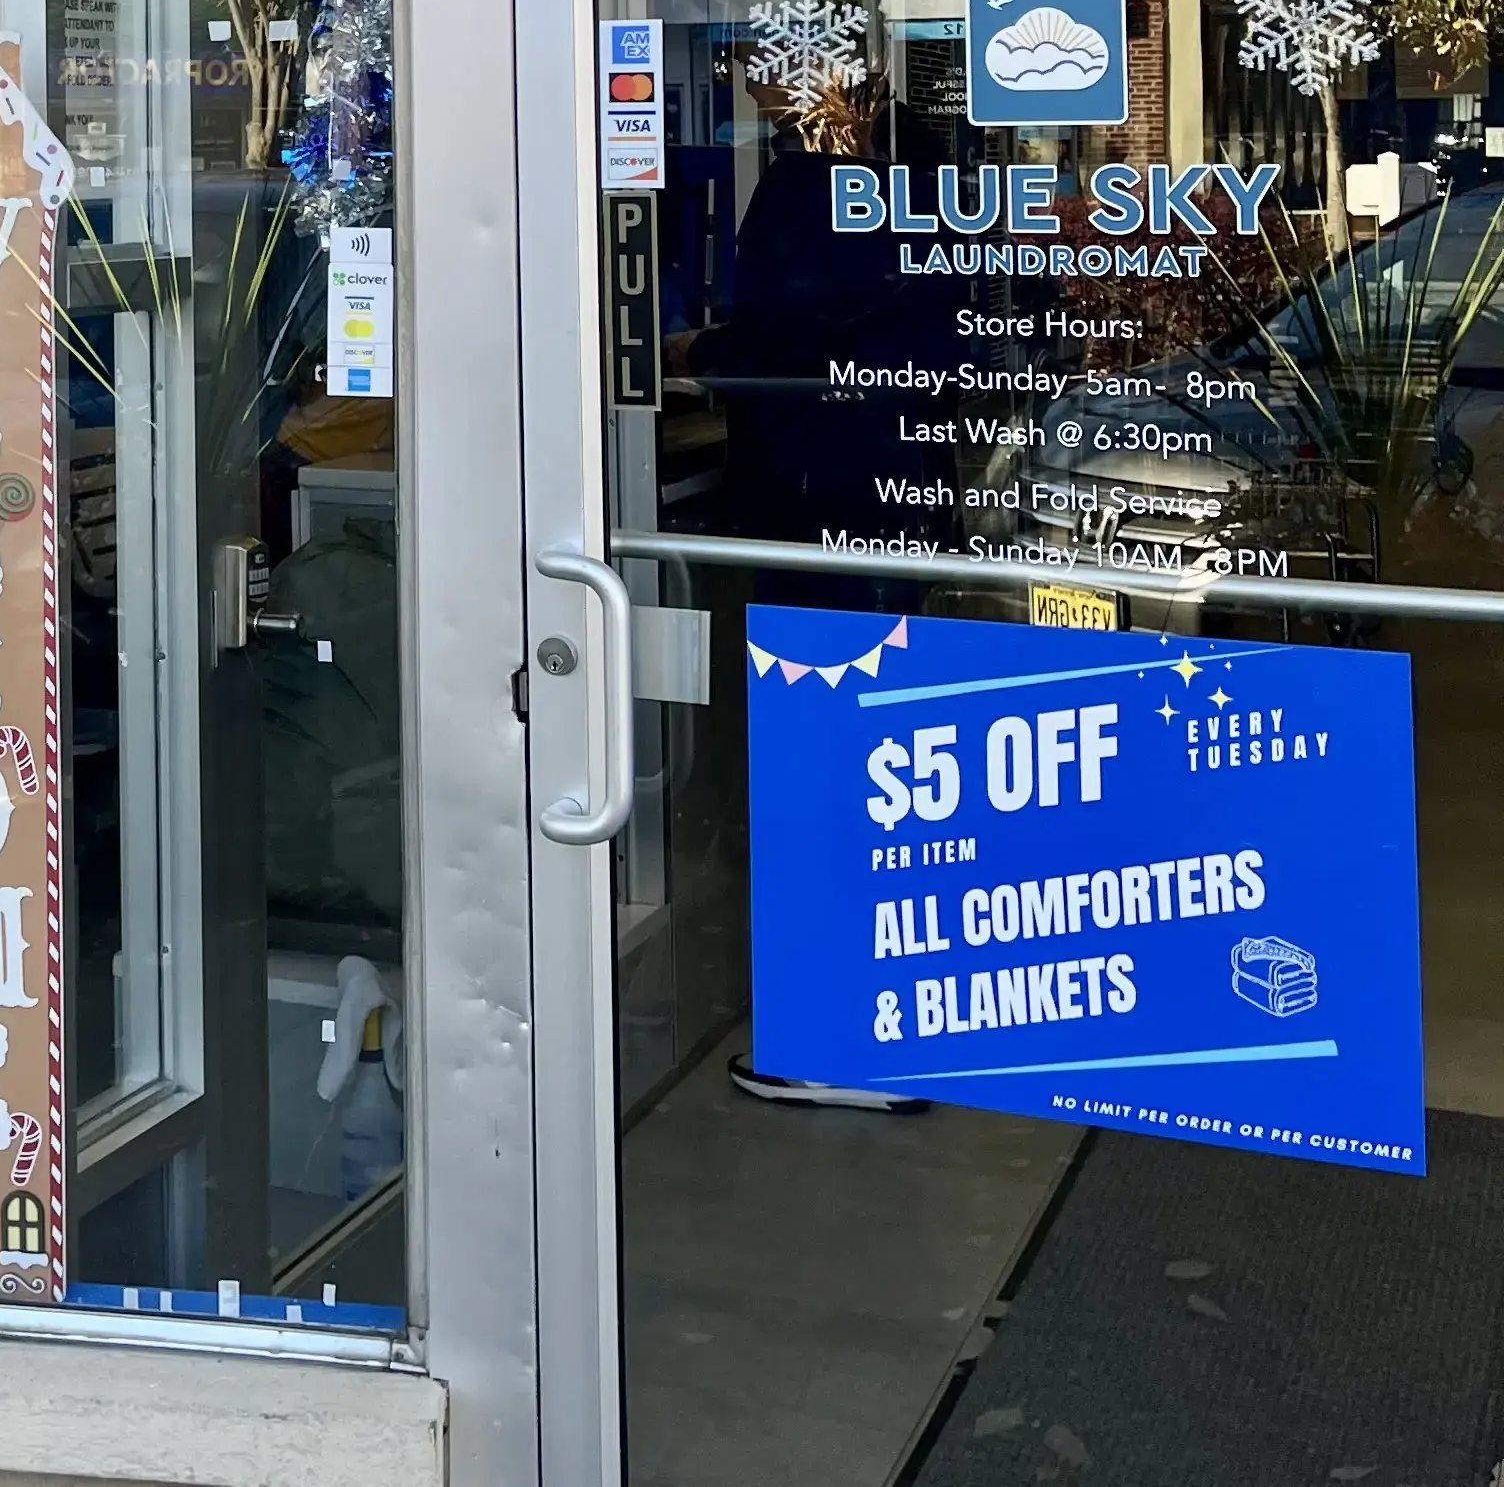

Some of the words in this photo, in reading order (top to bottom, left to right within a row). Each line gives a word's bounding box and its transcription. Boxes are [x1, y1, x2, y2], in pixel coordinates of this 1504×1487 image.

[613, 118, 651, 133] VISA
[610, 157, 656, 167] DISCOVER
[830, 163, 1062, 235] BLUE
[1088, 162, 1282, 236] SKY
[347, 272, 388, 285] clover
[899, 242, 1208, 278] LAUNDROMAT
[348, 301, 371, 311] VISA
[617, 202, 646, 399] PULL
[956, 309, 1035, 338] Store
[1045, 310, 1144, 339] Hours:
[828, 360, 1068, 400] Monday-Sunday
[1186, 372, 1257, 407] 8pm
[899, 415, 957, 444] Last
[965, 418, 1046, 447] Wash
[1056, 420, 1084, 449] @
[1093, 423, 1213, 459] 6:30pm
[874, 477, 954, 507] Wash
[965, 481, 1021, 511] and
[1031, 482, 1099, 514] Fold
[1108, 489, 1222, 519] Service
[821, 529, 938, 563] Monday
[968, 535, 1079, 572] Sunday
[1092, 540, 1183, 571] 10AM
[1214, 547, 1289, 578] 8PM
[1187, 706, 1286, 744] EVERY
[865, 724, 963, 831] $5
[985, 702, 1119, 812] OFF
[1188, 731, 1330, 772] TUESDAY
[871, 845, 913, 872] PER
[923, 836, 978, 866] ITEM
[873, 894, 951, 960] ALL
[962, 848, 1266, 948] COMFORTERS
[872, 990, 904, 1043] &
[916, 952, 1138, 1038] BLANKETS
[1052, 1094, 1079, 1111] NO
[1083, 1098, 1133, 1120] LIMIT
[1138, 1107, 1170, 1126] PER
[1175, 1113, 1233, 1136] ORDER
[1238, 1121, 1265, 1139] OR
[1270, 1125, 1304, 1145] PER
[1309, 1131, 1414, 1162] CUSTOMER
